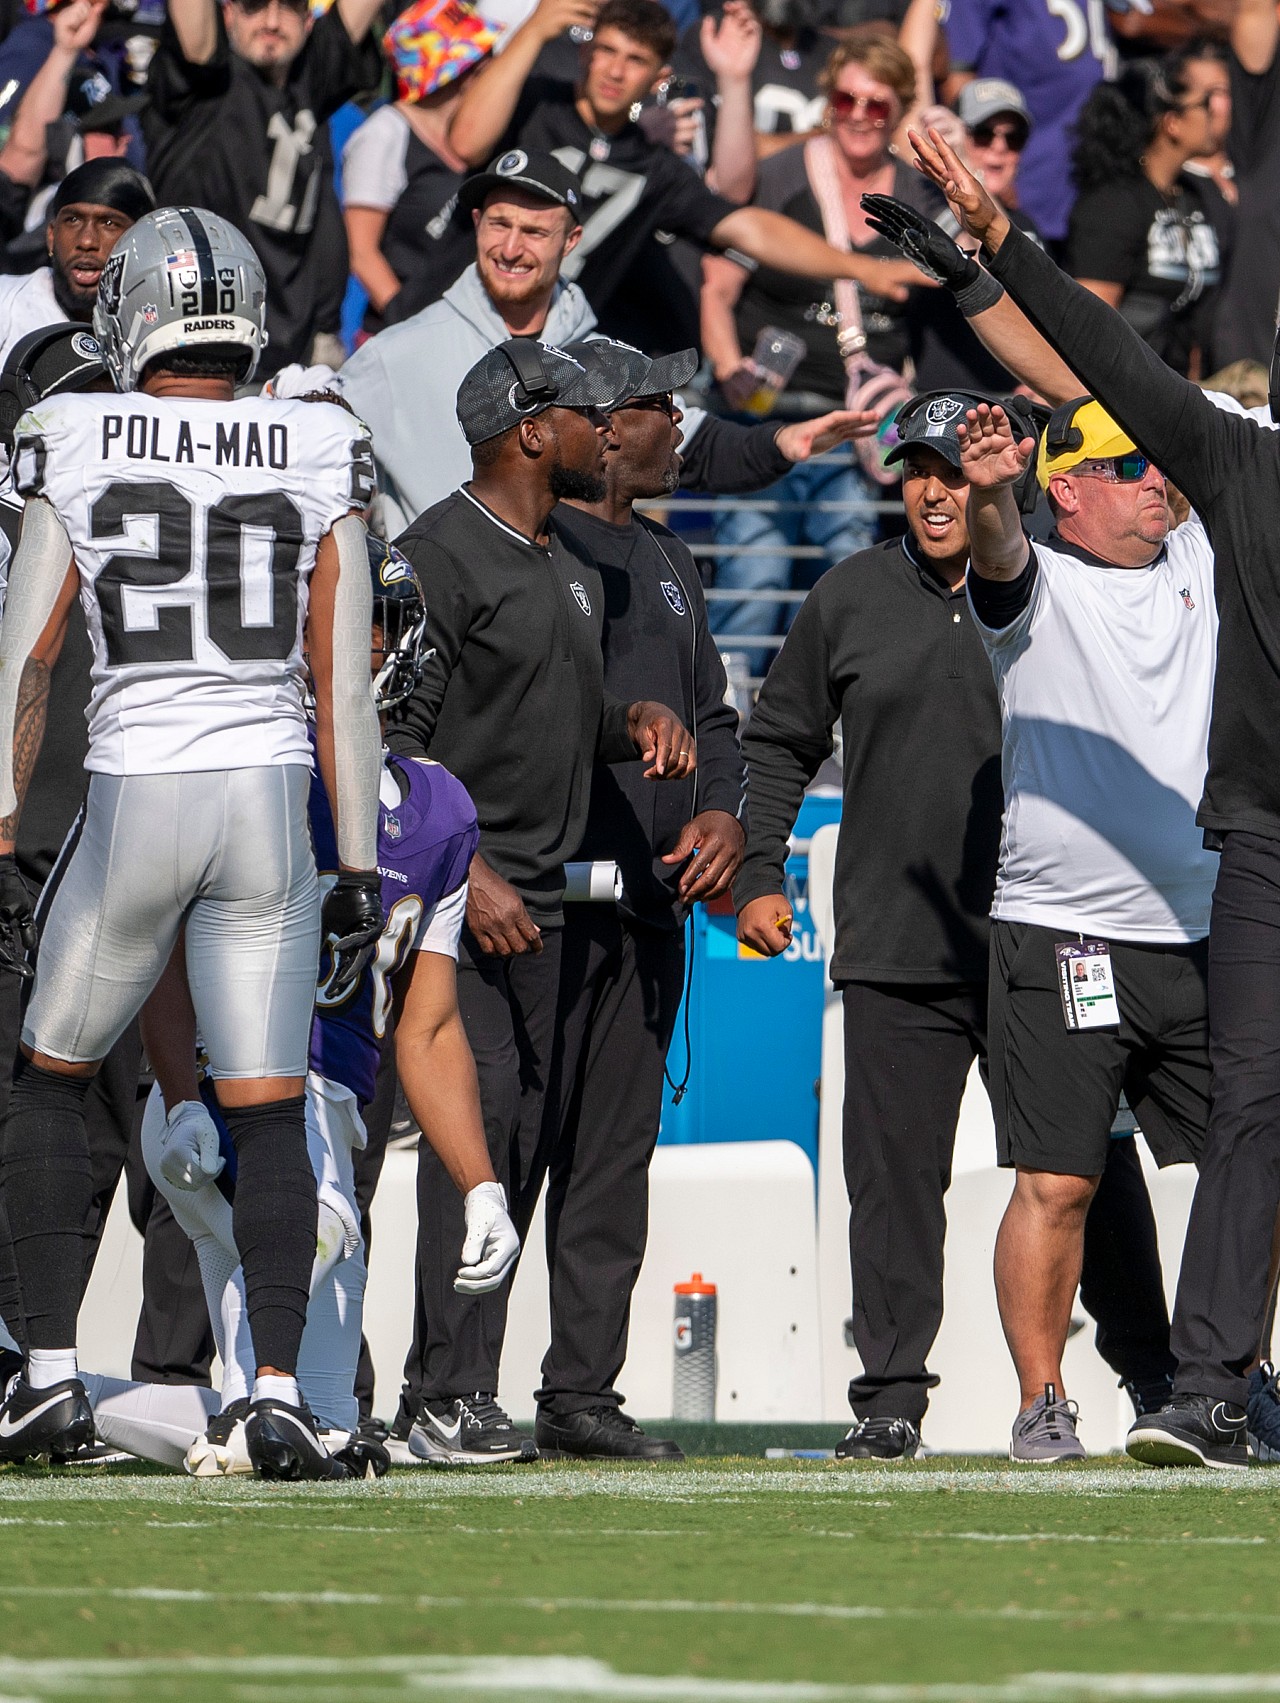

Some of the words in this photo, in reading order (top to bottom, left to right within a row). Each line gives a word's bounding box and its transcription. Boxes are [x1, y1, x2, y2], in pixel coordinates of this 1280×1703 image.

[184, 319, 236, 334] RAIDERS
[102, 414, 288, 470] POLA-MAO
[87, 477, 305, 671] 20
[673, 1316, 692, 1350] G
